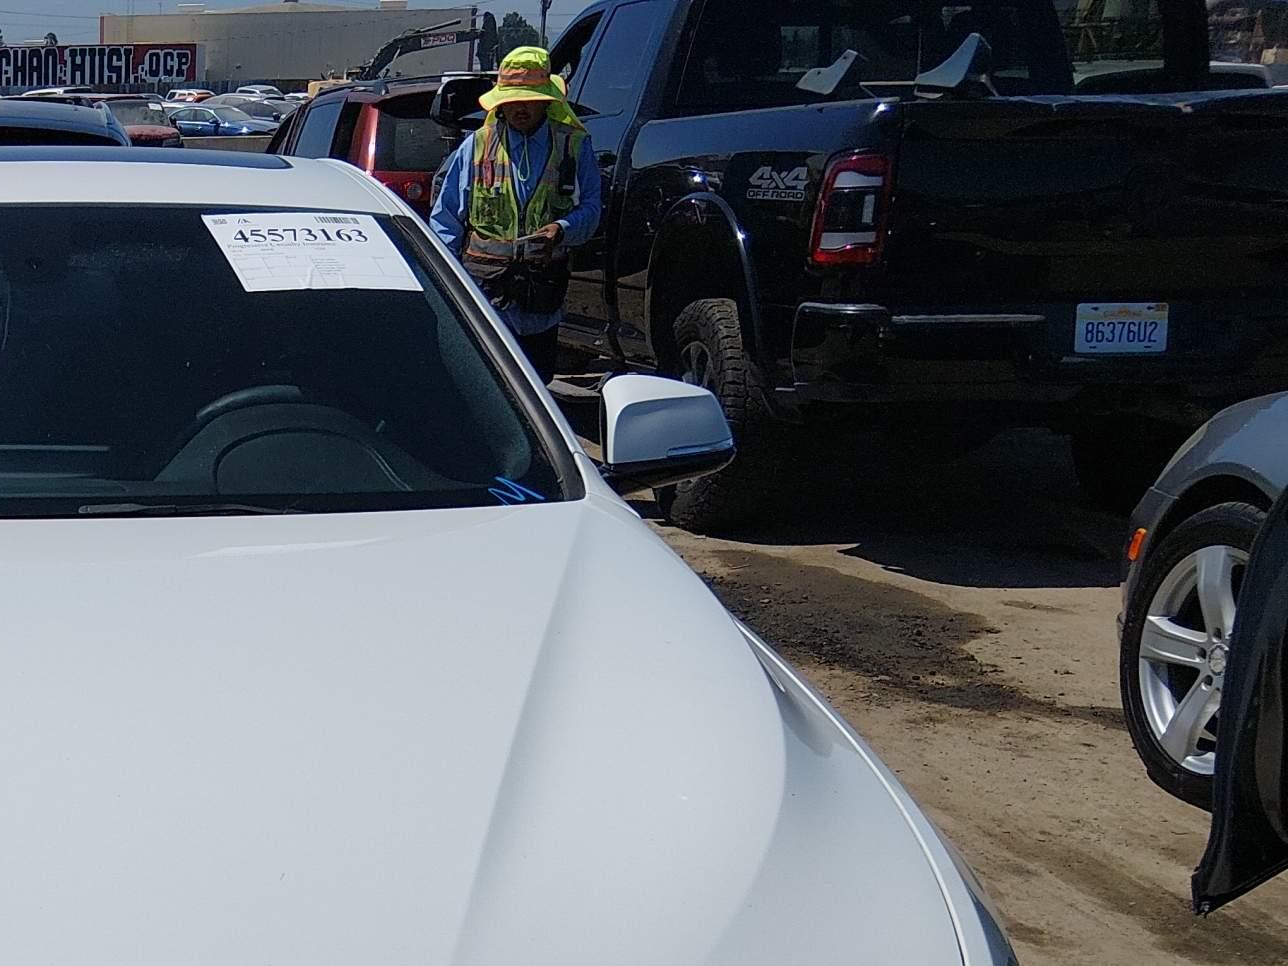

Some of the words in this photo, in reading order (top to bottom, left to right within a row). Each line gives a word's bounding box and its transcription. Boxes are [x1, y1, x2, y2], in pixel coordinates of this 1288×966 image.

[748, 190, 770, 199] OFF
[770, 190, 804, 200] ROAD
[233, 228, 368, 243] 45573163
[1085, 321, 1158, 343] 86376U2
